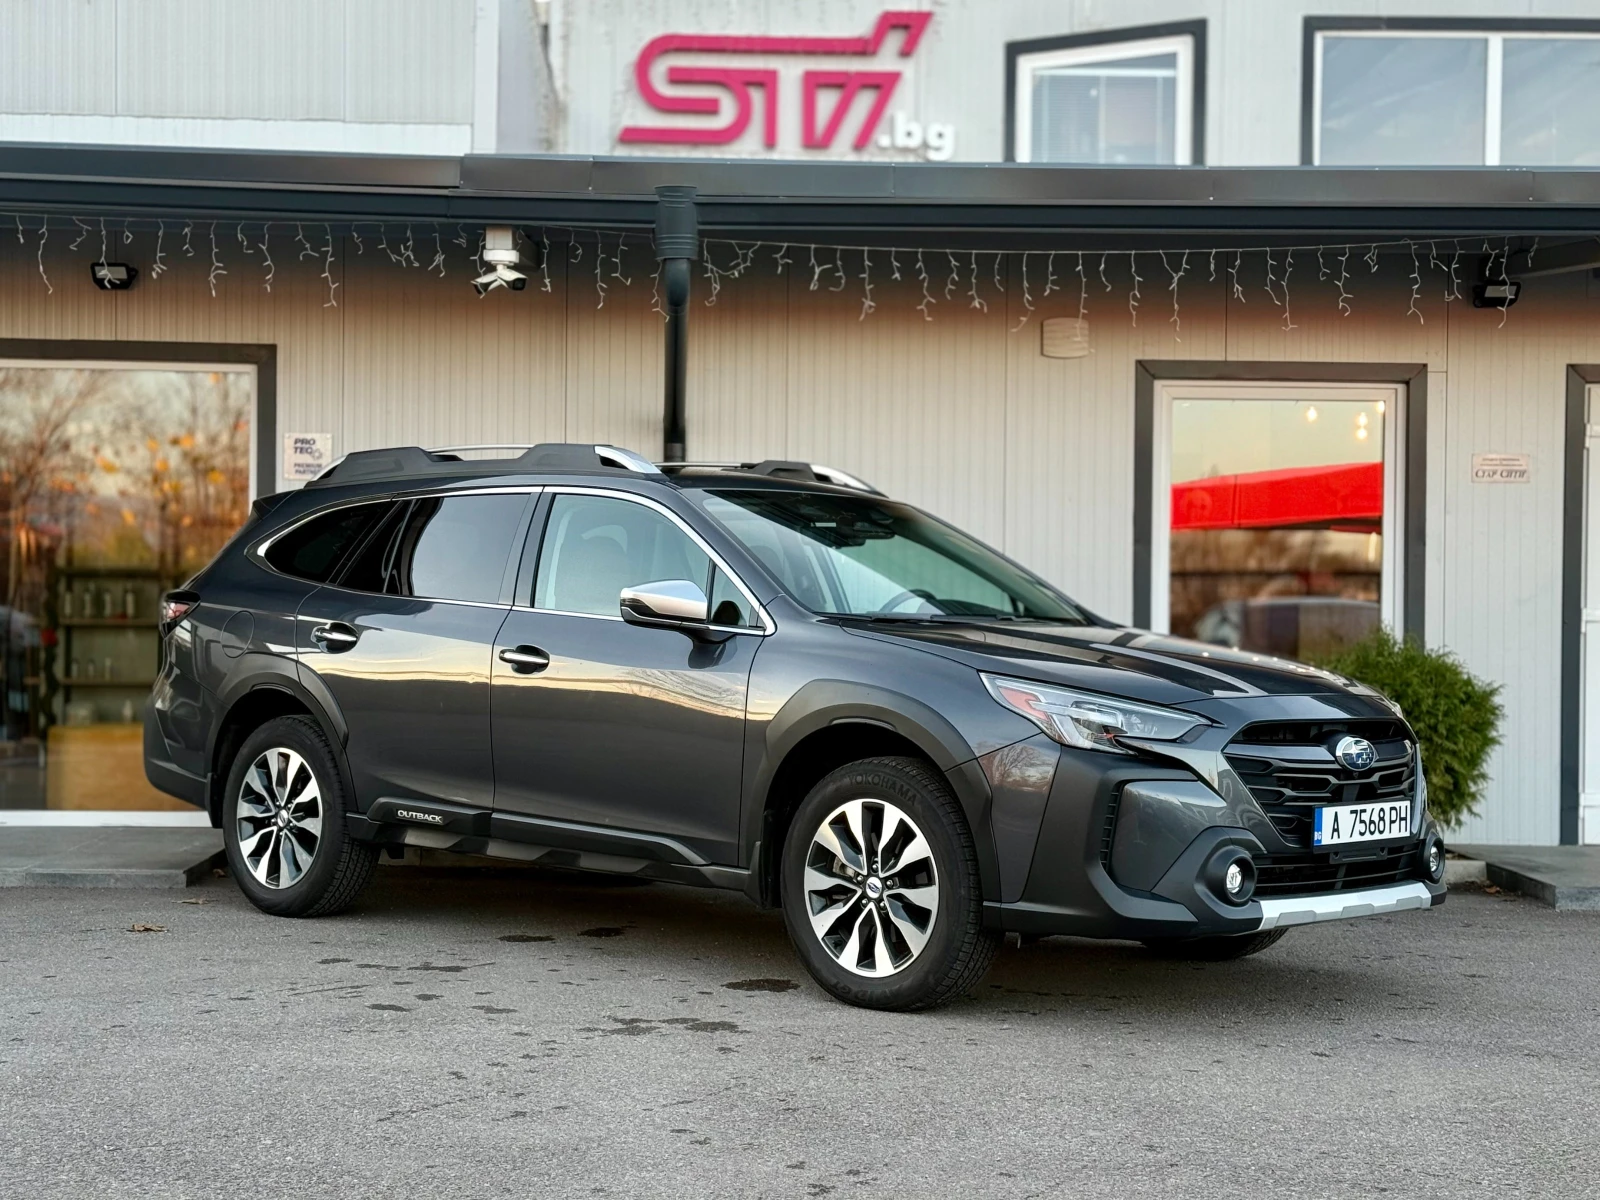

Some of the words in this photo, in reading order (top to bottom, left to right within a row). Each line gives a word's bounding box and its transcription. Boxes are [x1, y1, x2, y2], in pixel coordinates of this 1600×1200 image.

[293, 438, 316, 446] PRO
[847, 771, 918, 807] YOKOHAMA
[397, 809, 443, 824] OUTBACK
[1331, 811, 1341, 840] A
[1349, 807, 1386, 838] 7568
